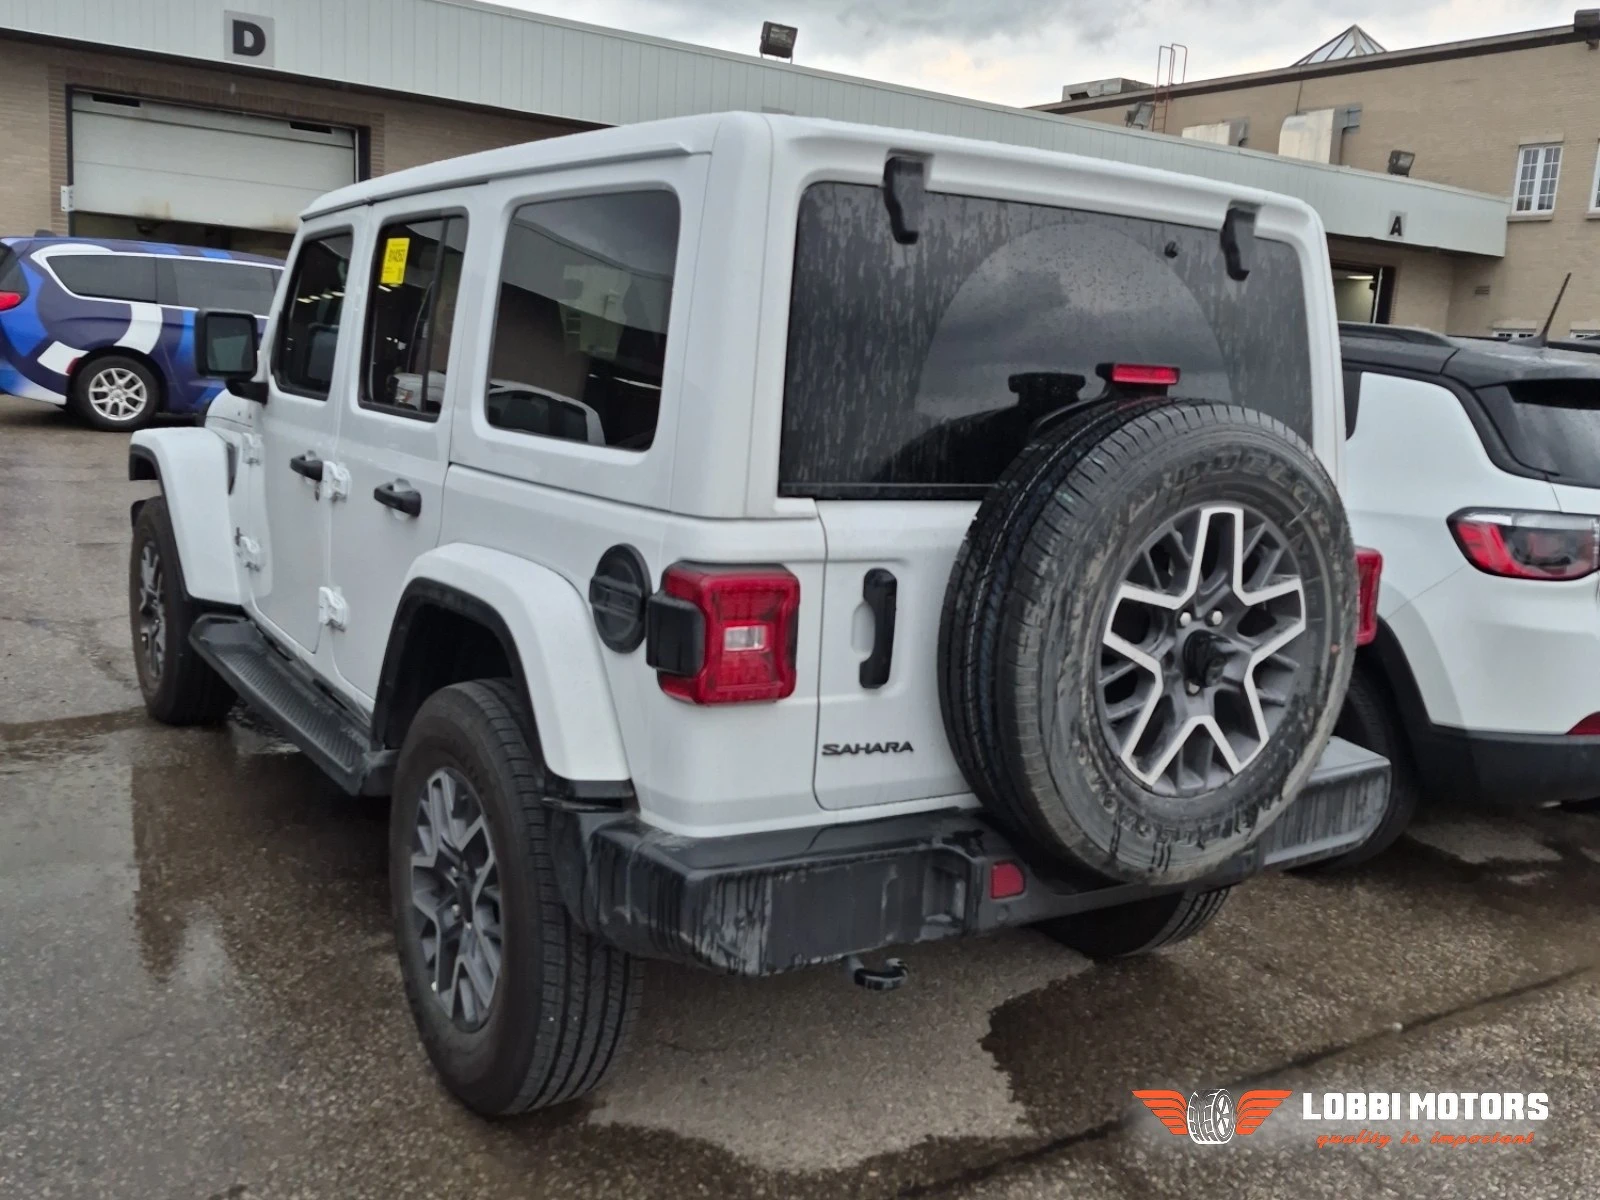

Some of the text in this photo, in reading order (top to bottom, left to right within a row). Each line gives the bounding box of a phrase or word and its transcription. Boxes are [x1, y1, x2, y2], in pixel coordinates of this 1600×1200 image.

[232, 19, 266, 57] D
[1390, 215, 1402, 237] A
[822, 741, 914, 755] SAHARA
